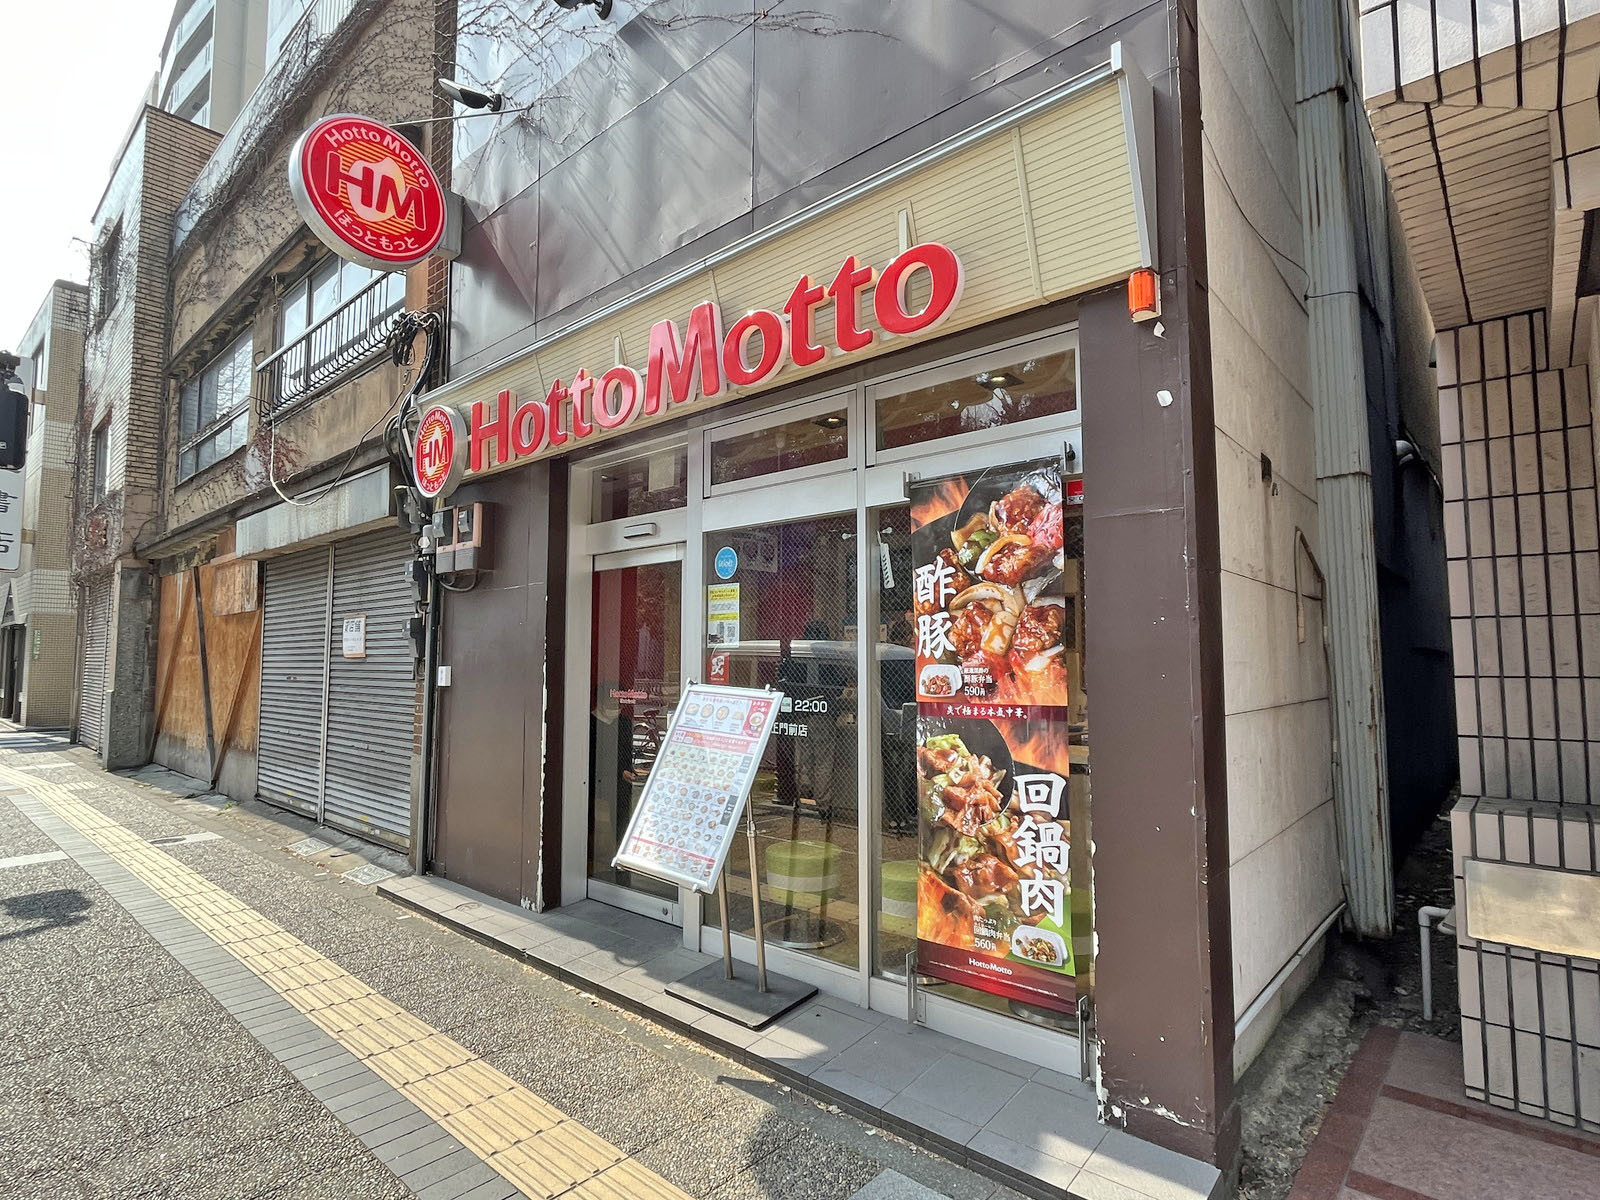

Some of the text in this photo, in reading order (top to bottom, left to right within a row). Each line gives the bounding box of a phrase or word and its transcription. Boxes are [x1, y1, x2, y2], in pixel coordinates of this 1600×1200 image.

[324, 126, 429, 188] Hotto Motto
[333, 209, 419, 251] ほっともっと
[421, 472, 447, 491] ほっともっと
[914, 556, 957, 659] 酢豚
[963, 674, 993, 684] 酢豚弁当
[794, 699, 828, 713] 22:00
[1012, 772, 1071, 928] 回鍋肉
[973, 925, 1011, 942] 回鍋肉弁当
